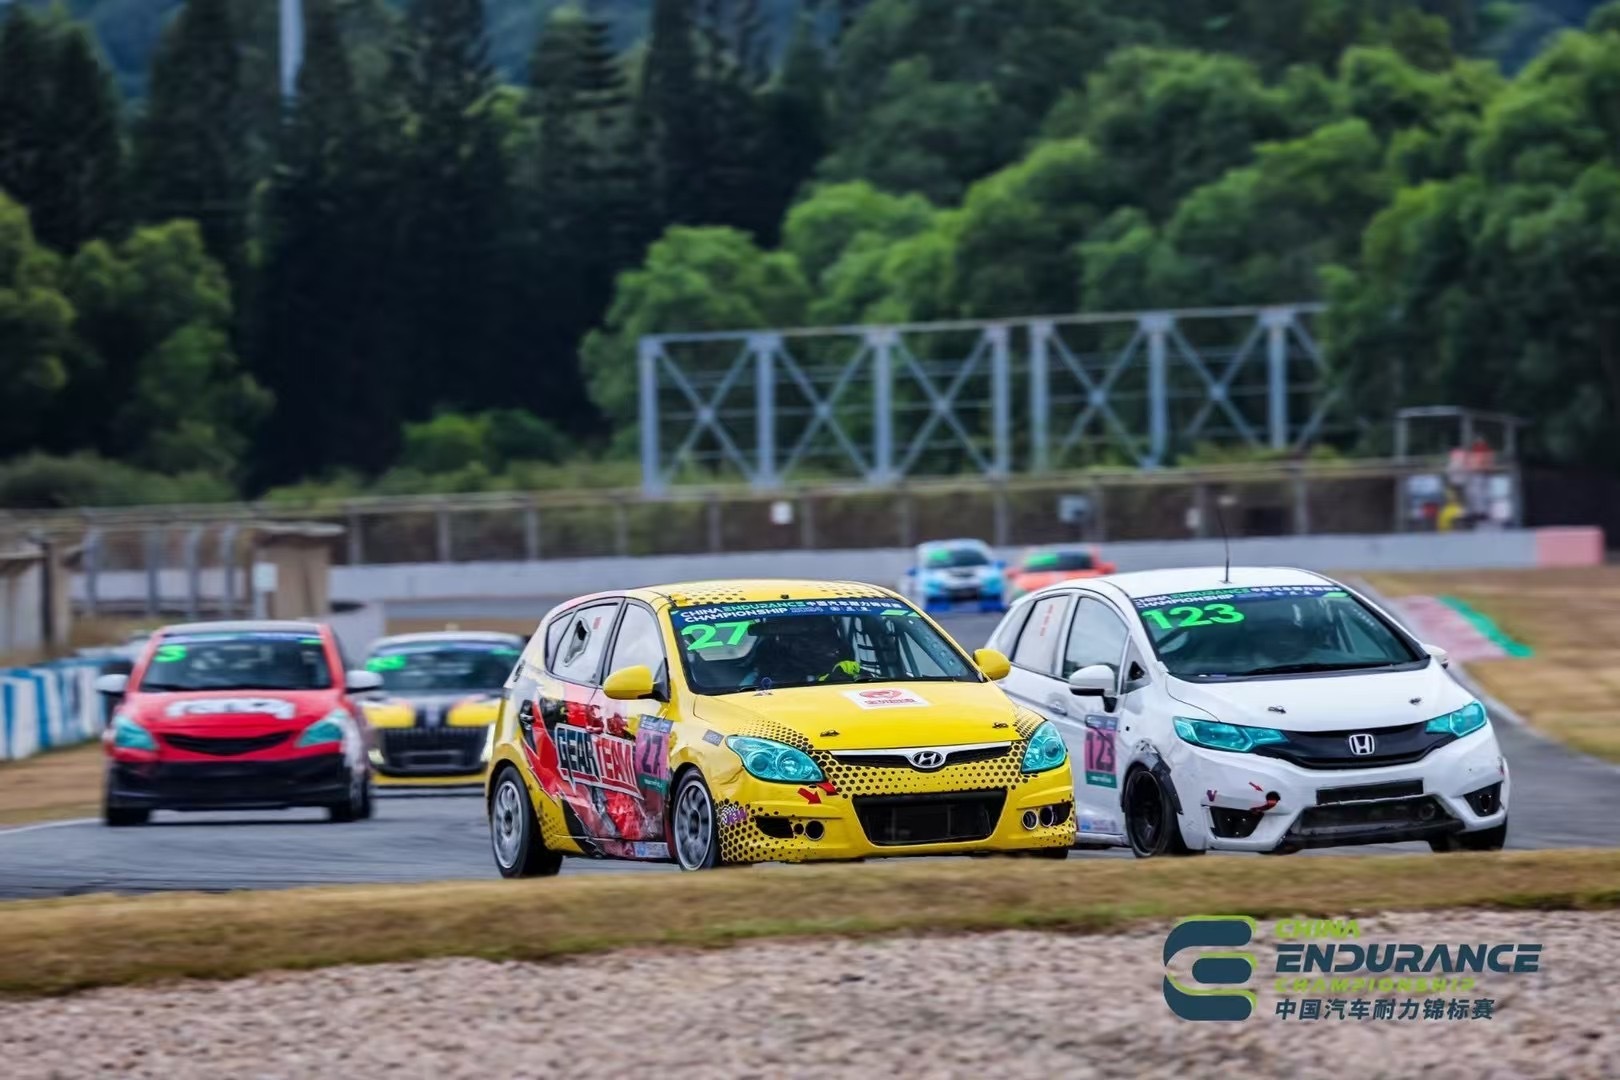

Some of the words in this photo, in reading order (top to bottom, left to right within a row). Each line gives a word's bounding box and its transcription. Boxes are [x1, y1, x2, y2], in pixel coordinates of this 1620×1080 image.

[680, 607, 723, 618] CHINA
[721, 601, 806, 612] ENDURANCE
[684, 607, 788, 623] CHAMPIONSHIP
[1141, 603, 1245, 629] 123
[680, 621, 751, 650] 27
[642, 732, 663, 775] 27
[1086, 731, 1115, 773] 123
